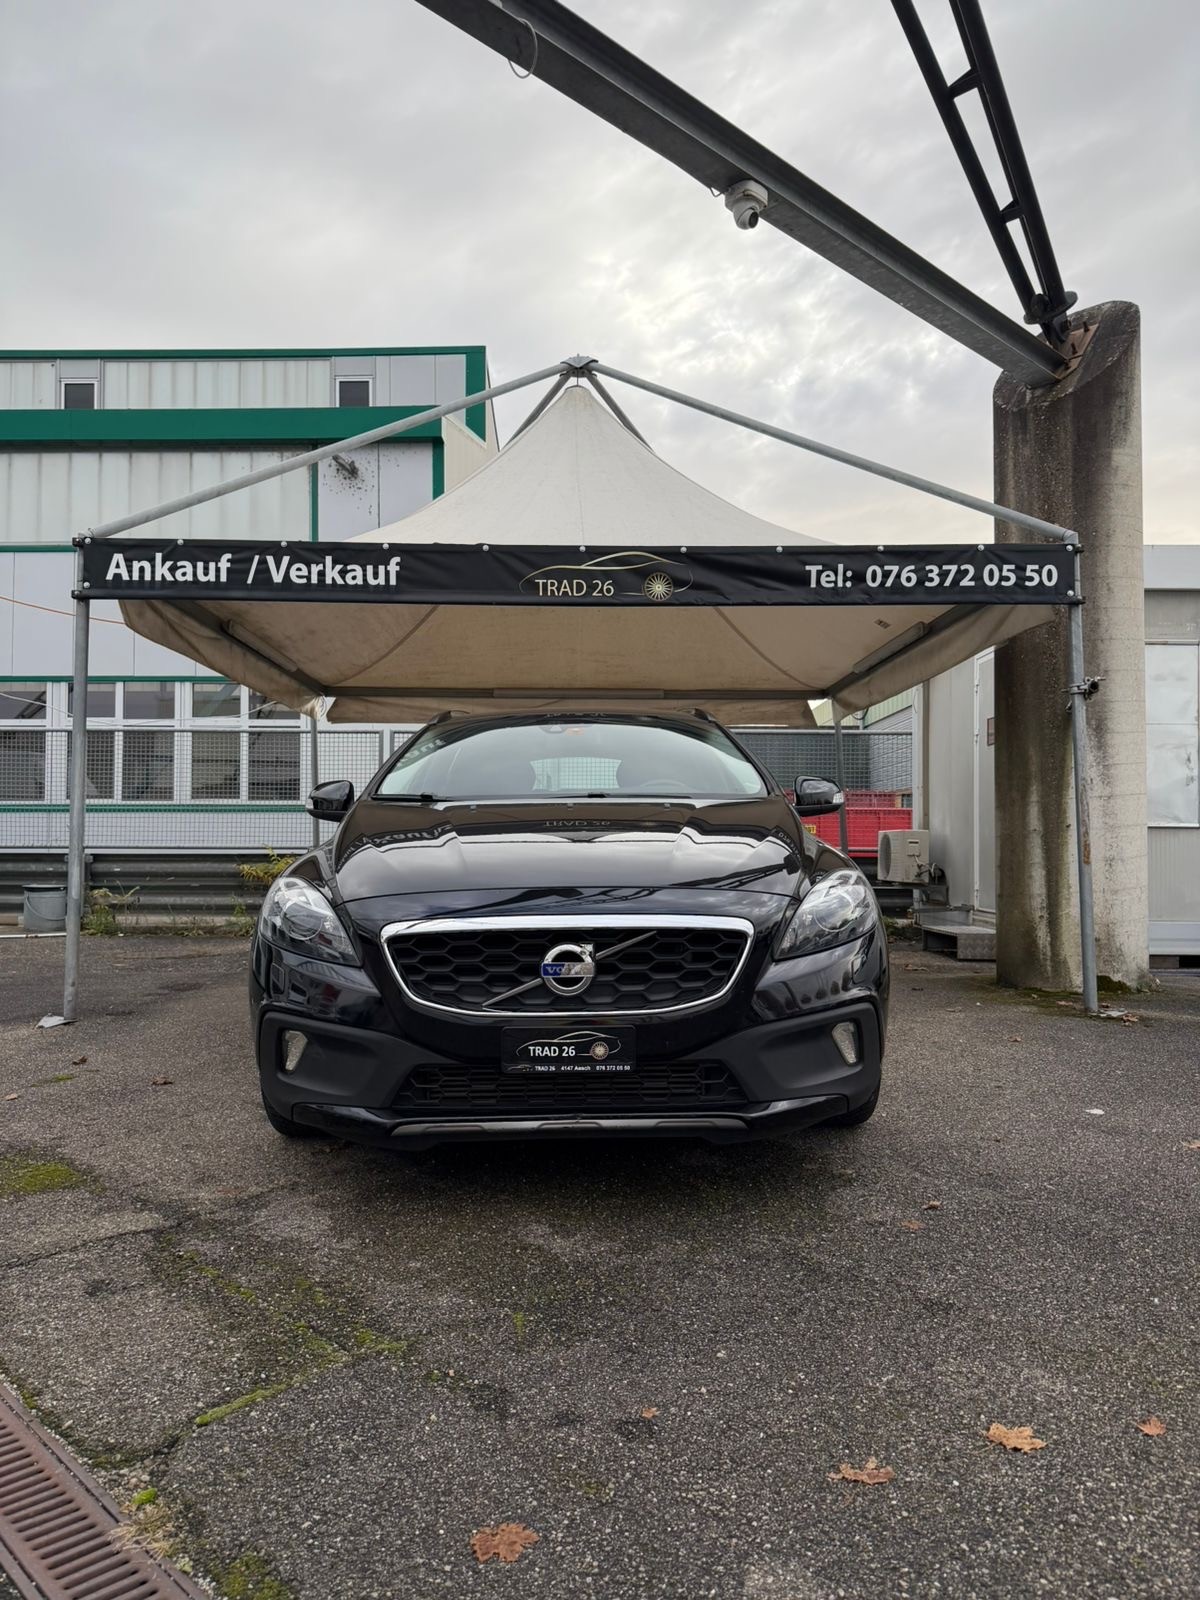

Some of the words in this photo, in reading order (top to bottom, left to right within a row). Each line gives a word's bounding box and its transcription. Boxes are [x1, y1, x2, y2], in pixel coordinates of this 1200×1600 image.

[105, 552, 232, 583] Ankauf
[805, 563, 853, 588] Tel:
[865, 564, 918, 588] 076
[924, 564, 976, 588] 372
[982, 563, 1017, 587] 05
[1024, 564, 1058, 587] 50
[534, 579, 587, 596] TRAD
[591, 579, 615, 597] 26
[528, 1046, 559, 1057] TRAD
[562, 1046, 575, 1057] 26
